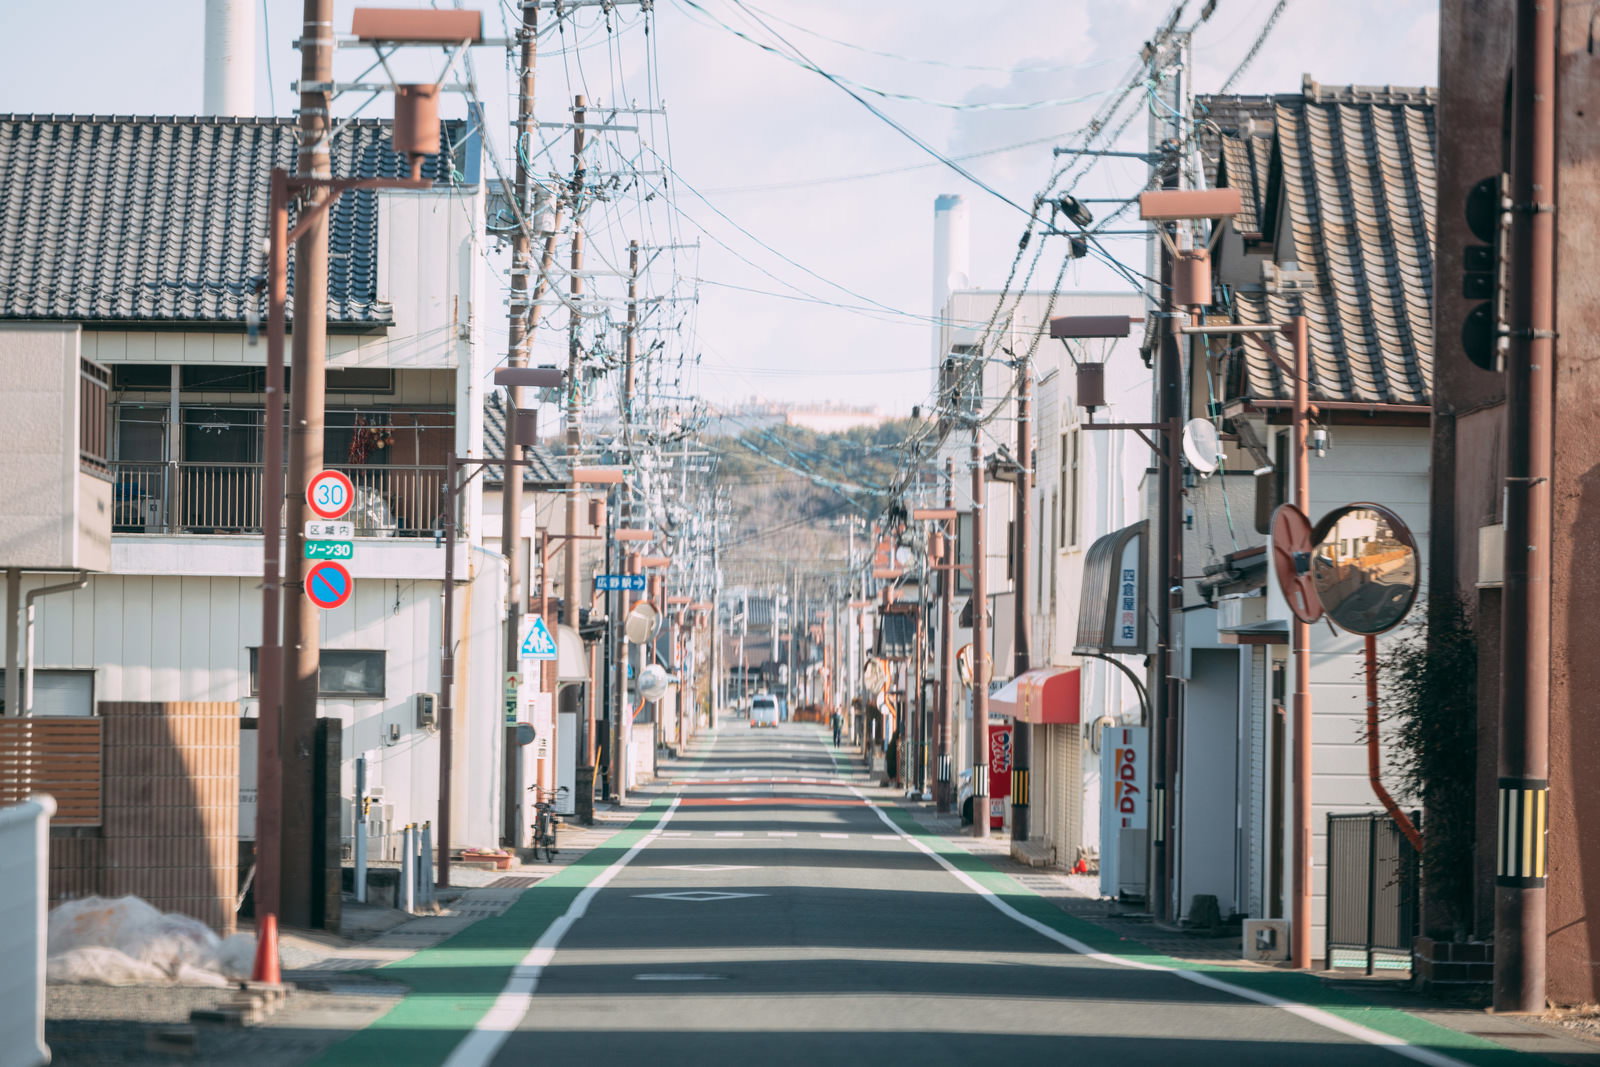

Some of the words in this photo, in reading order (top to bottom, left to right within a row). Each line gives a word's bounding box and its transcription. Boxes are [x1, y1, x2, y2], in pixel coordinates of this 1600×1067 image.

[318, 484, 343, 505] 30
[308, 544, 350, 556] ゾーン30
[1120, 748, 1140, 813] DyDo
